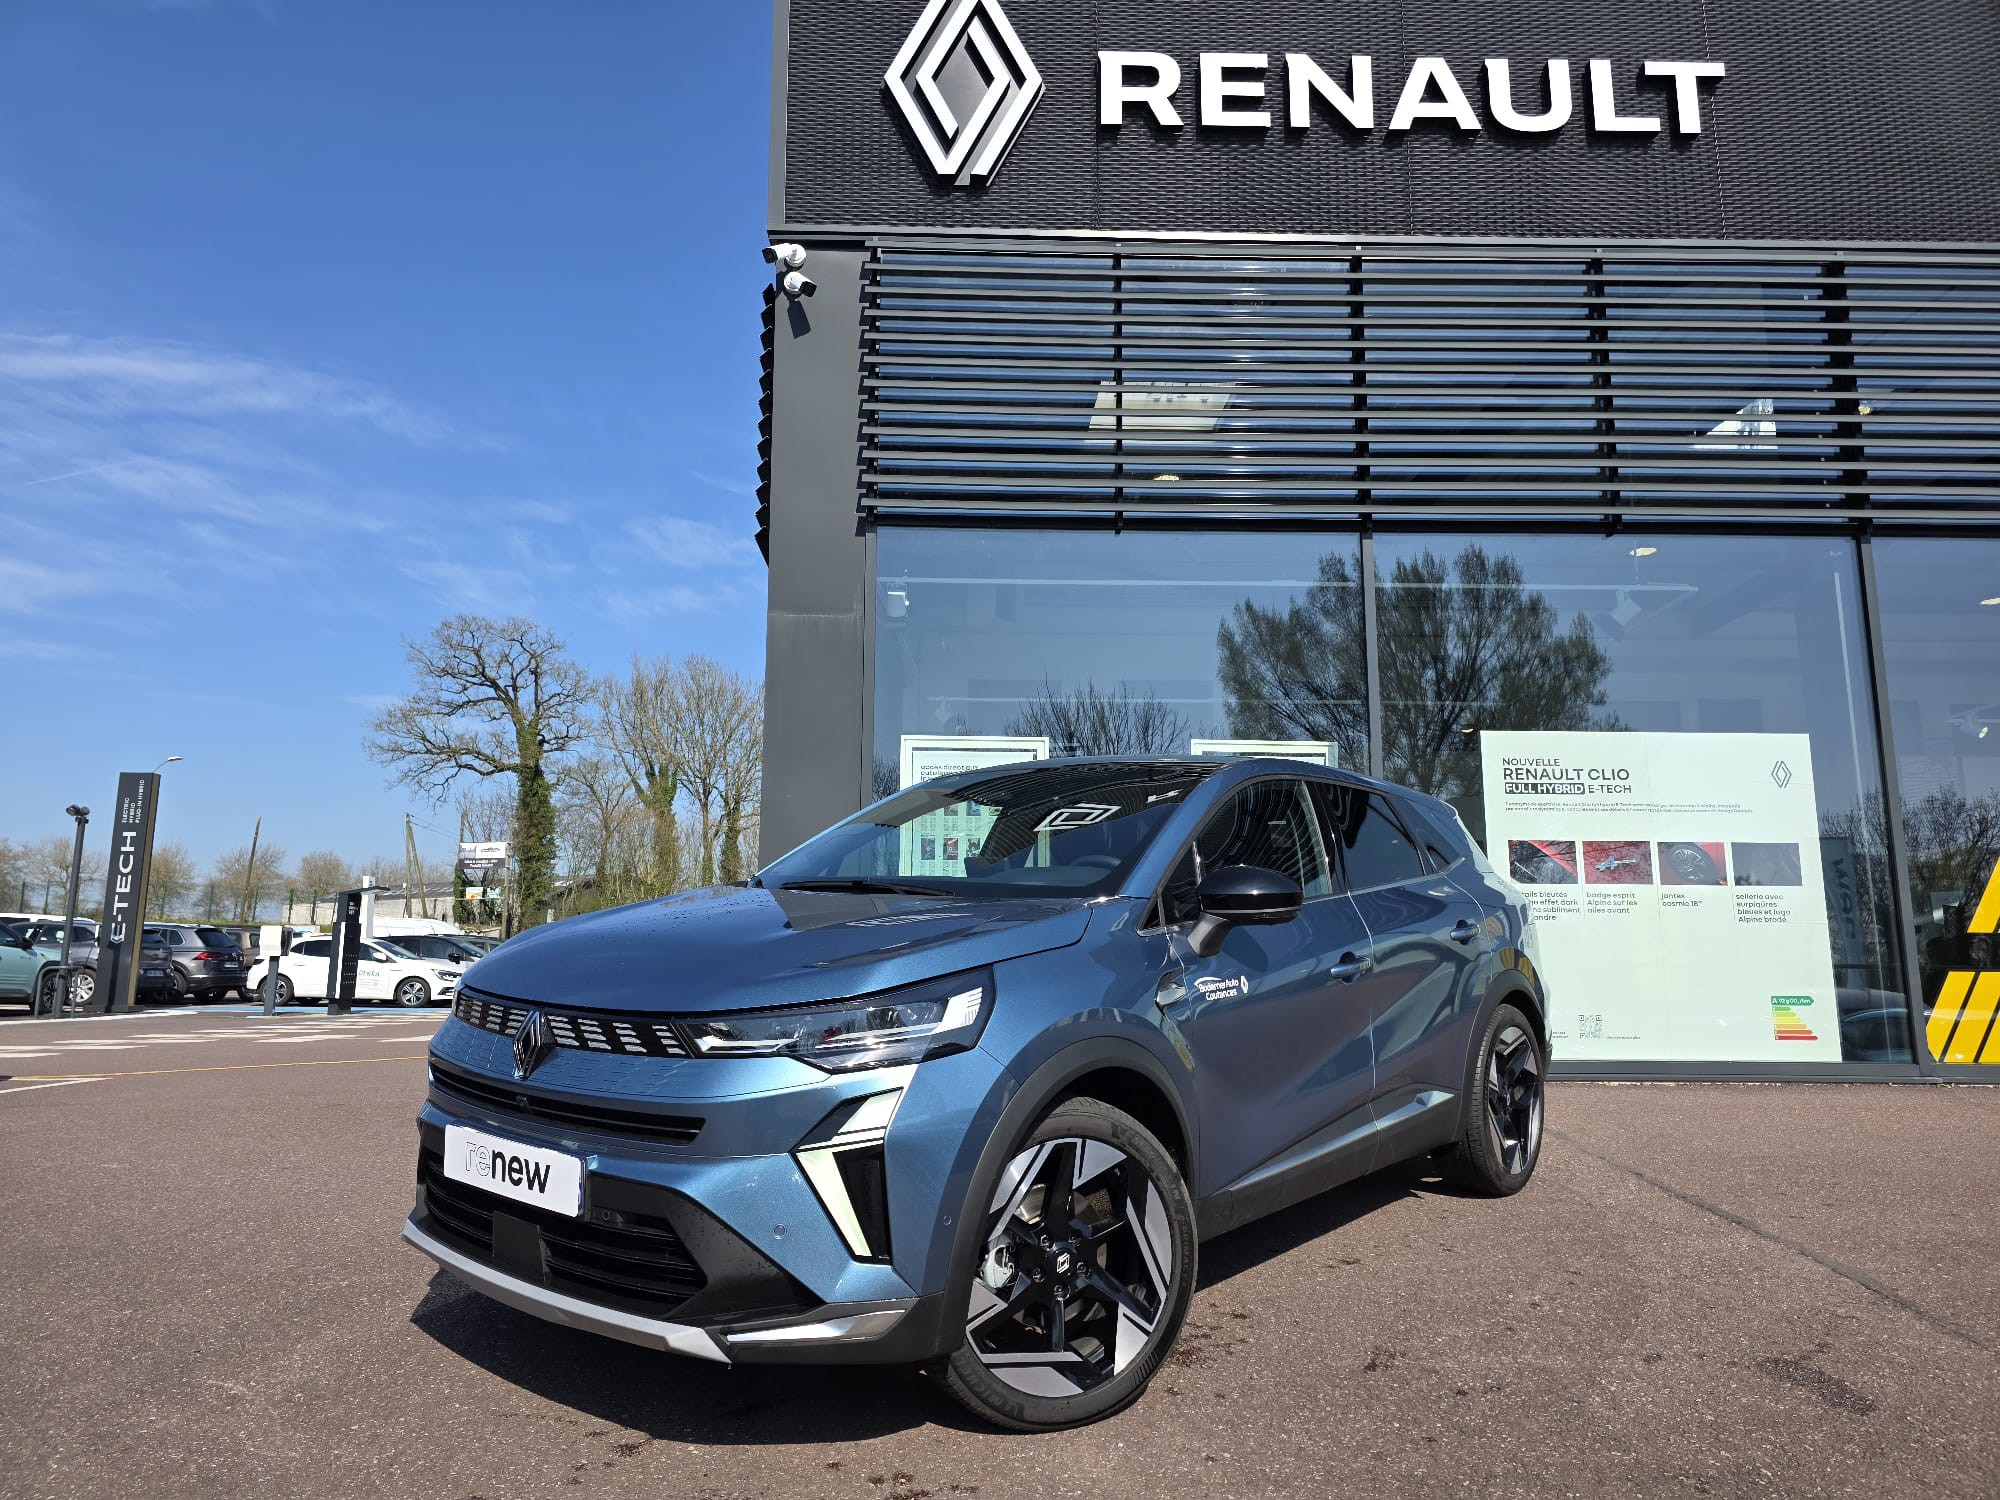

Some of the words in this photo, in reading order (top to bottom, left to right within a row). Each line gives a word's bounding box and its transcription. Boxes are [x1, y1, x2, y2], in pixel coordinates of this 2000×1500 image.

[1098, 49, 1726, 135] RENAULT
[1502, 757, 1560, 767] NOUVELLE
[1503, 767, 1584, 780] RENAULT
[1588, 768, 1630, 781] CLIO
[1505, 783, 1536, 794] FULL
[1537, 783, 1584, 794] HYBRID
[1588, 784, 1632, 794] E-TECH
[110, 831, 137, 944] E-TECH
[1586, 891, 1611, 899] badge
[1612, 891, 1636, 899] esprit
[1661, 893, 1685, 901] jantes
[465, 1141, 551, 1194] renew
